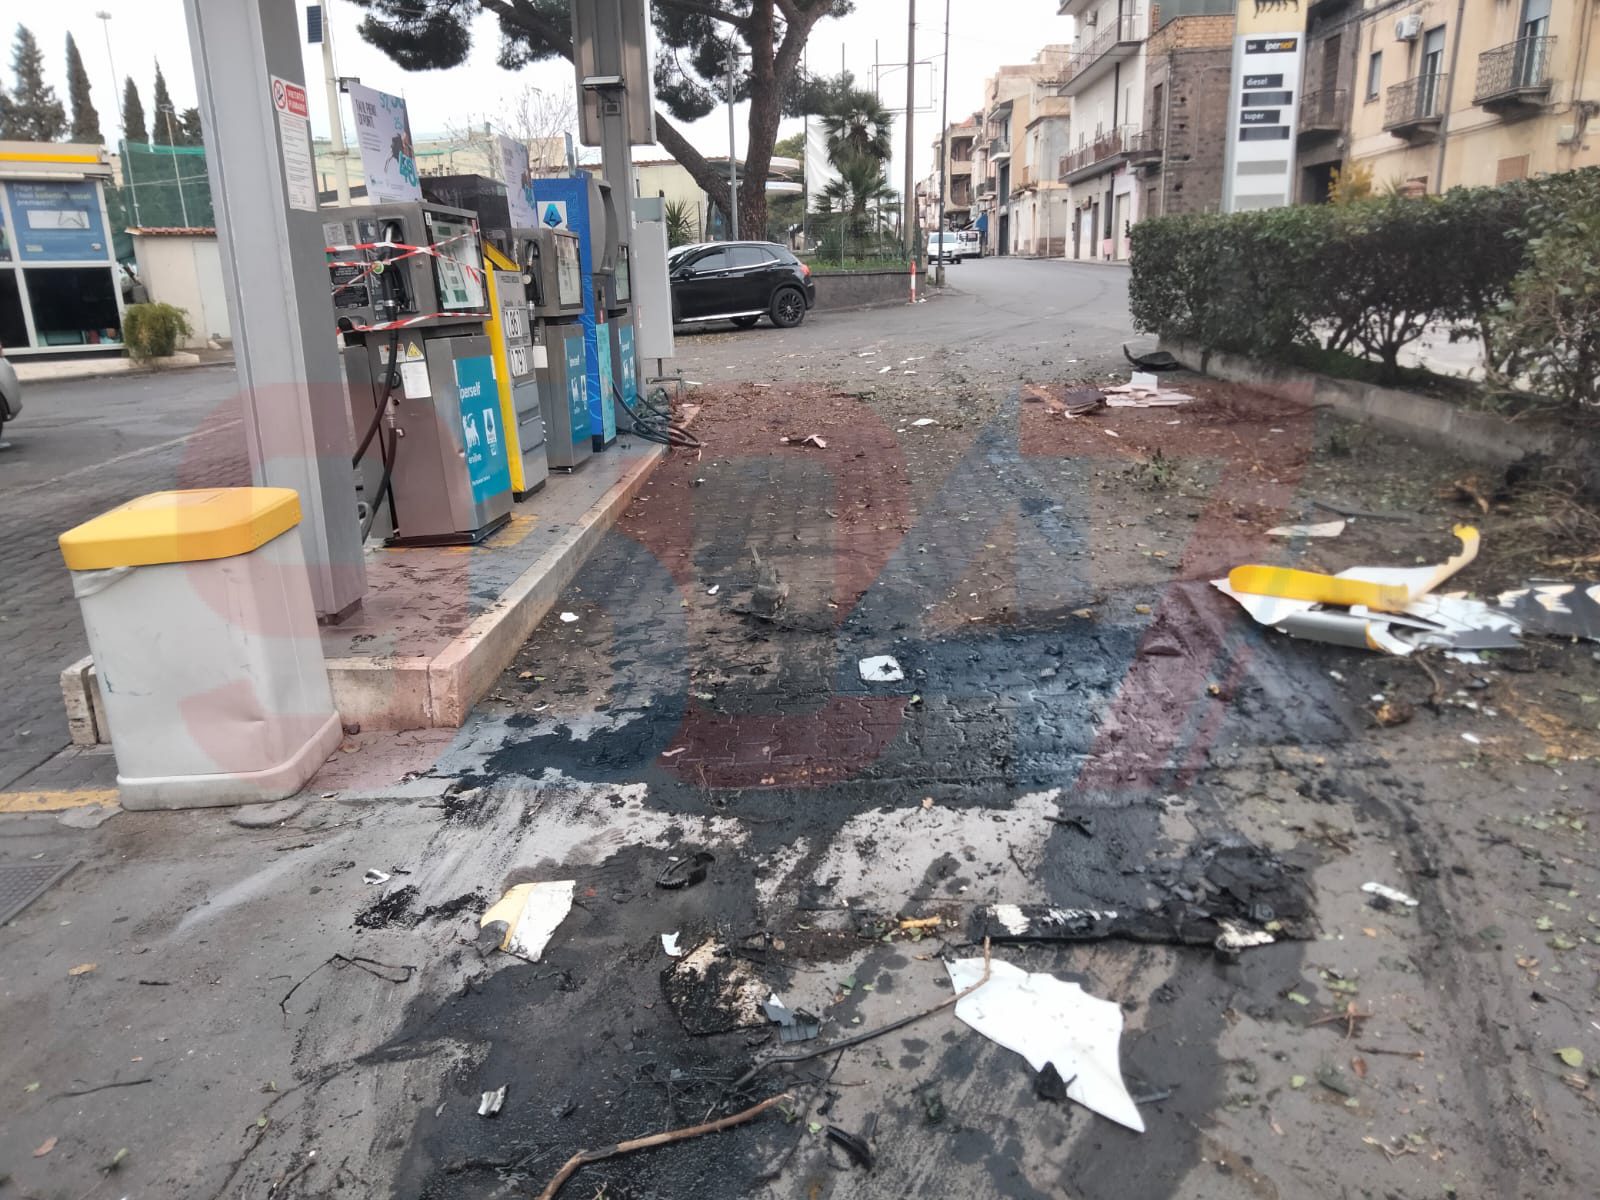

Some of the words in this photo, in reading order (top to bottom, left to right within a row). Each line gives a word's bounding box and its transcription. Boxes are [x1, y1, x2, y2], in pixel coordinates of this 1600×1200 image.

[1246, 77, 1268, 86] diesel
[287, 89, 305, 103] VIETATO
[1244, 112, 1264, 121] super
[458, 380, 480, 403] iperself
